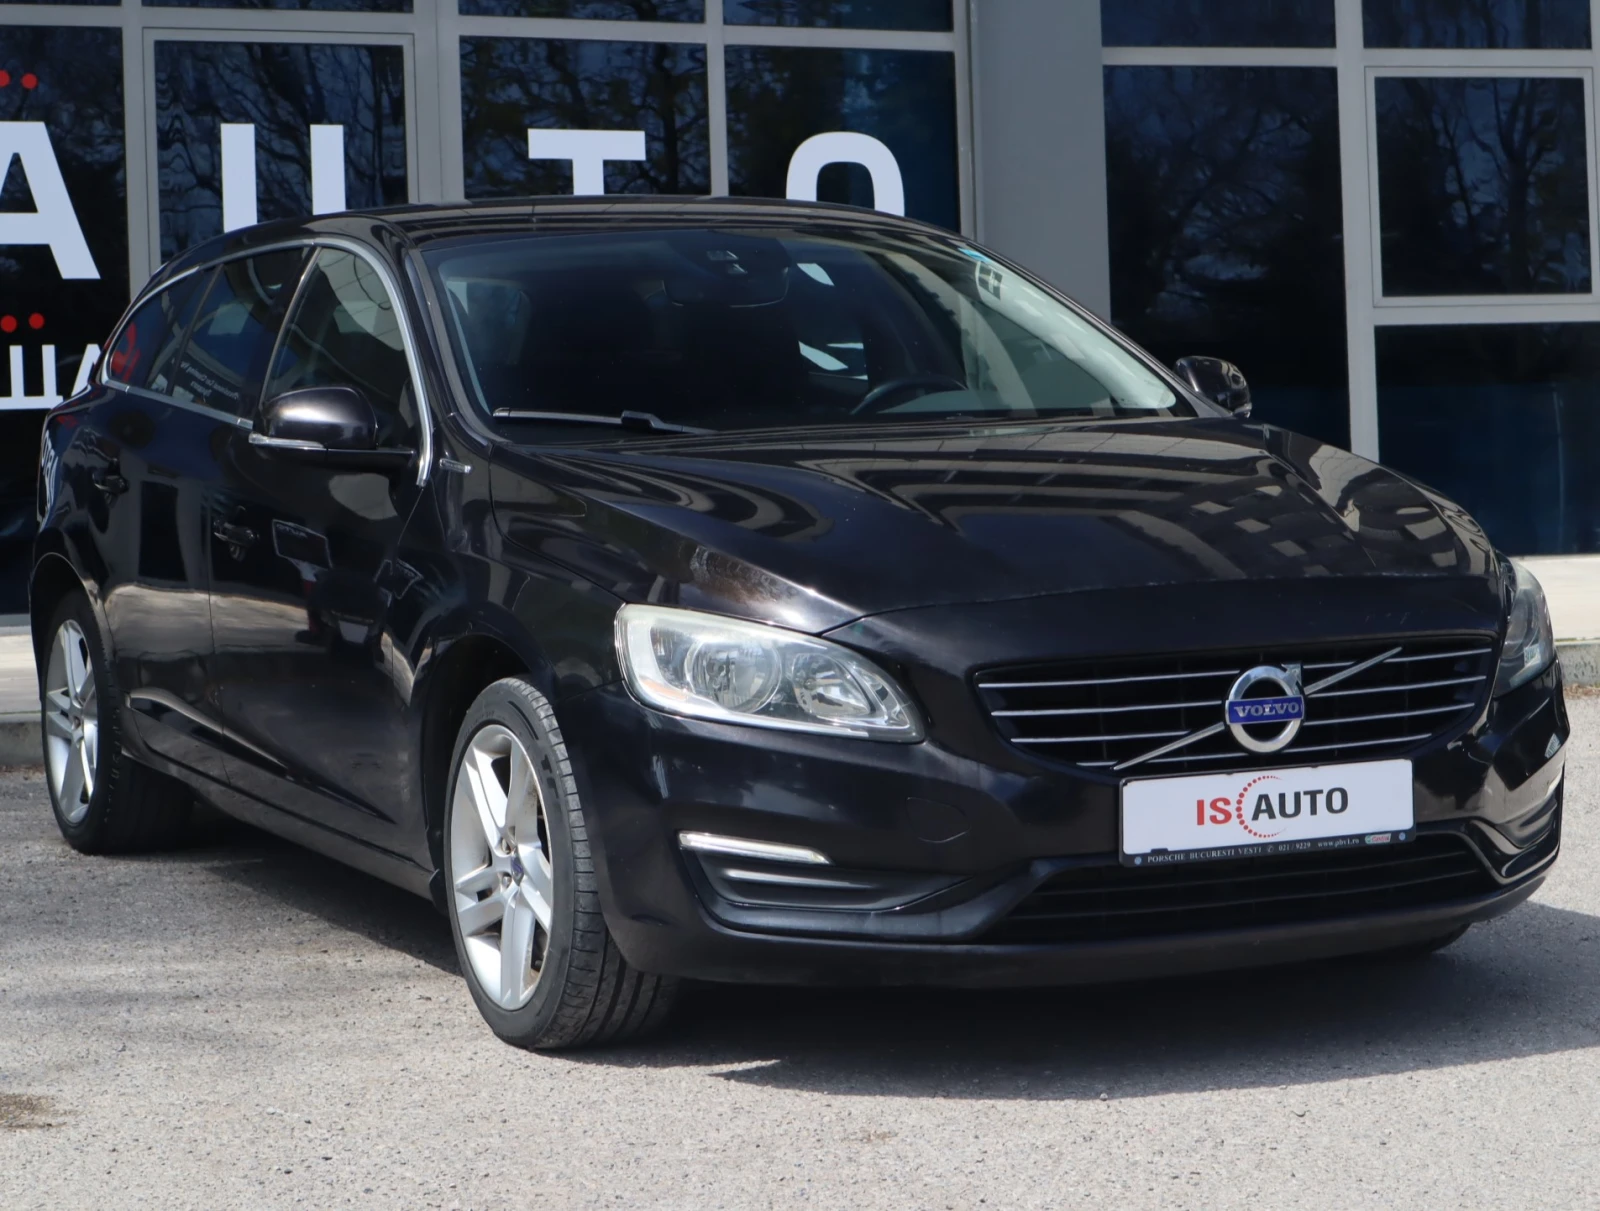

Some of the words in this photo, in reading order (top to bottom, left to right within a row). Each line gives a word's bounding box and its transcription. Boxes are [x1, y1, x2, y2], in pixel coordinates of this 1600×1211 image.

[1234, 702, 1299, 717] VOLVO
[1197, 797, 1232, 825] IS
[1252, 787, 1348, 821] AUTO
[1147, 853, 1185, 863] PORSCHE
[1190, 848, 1235, 860] BUCURESTI
